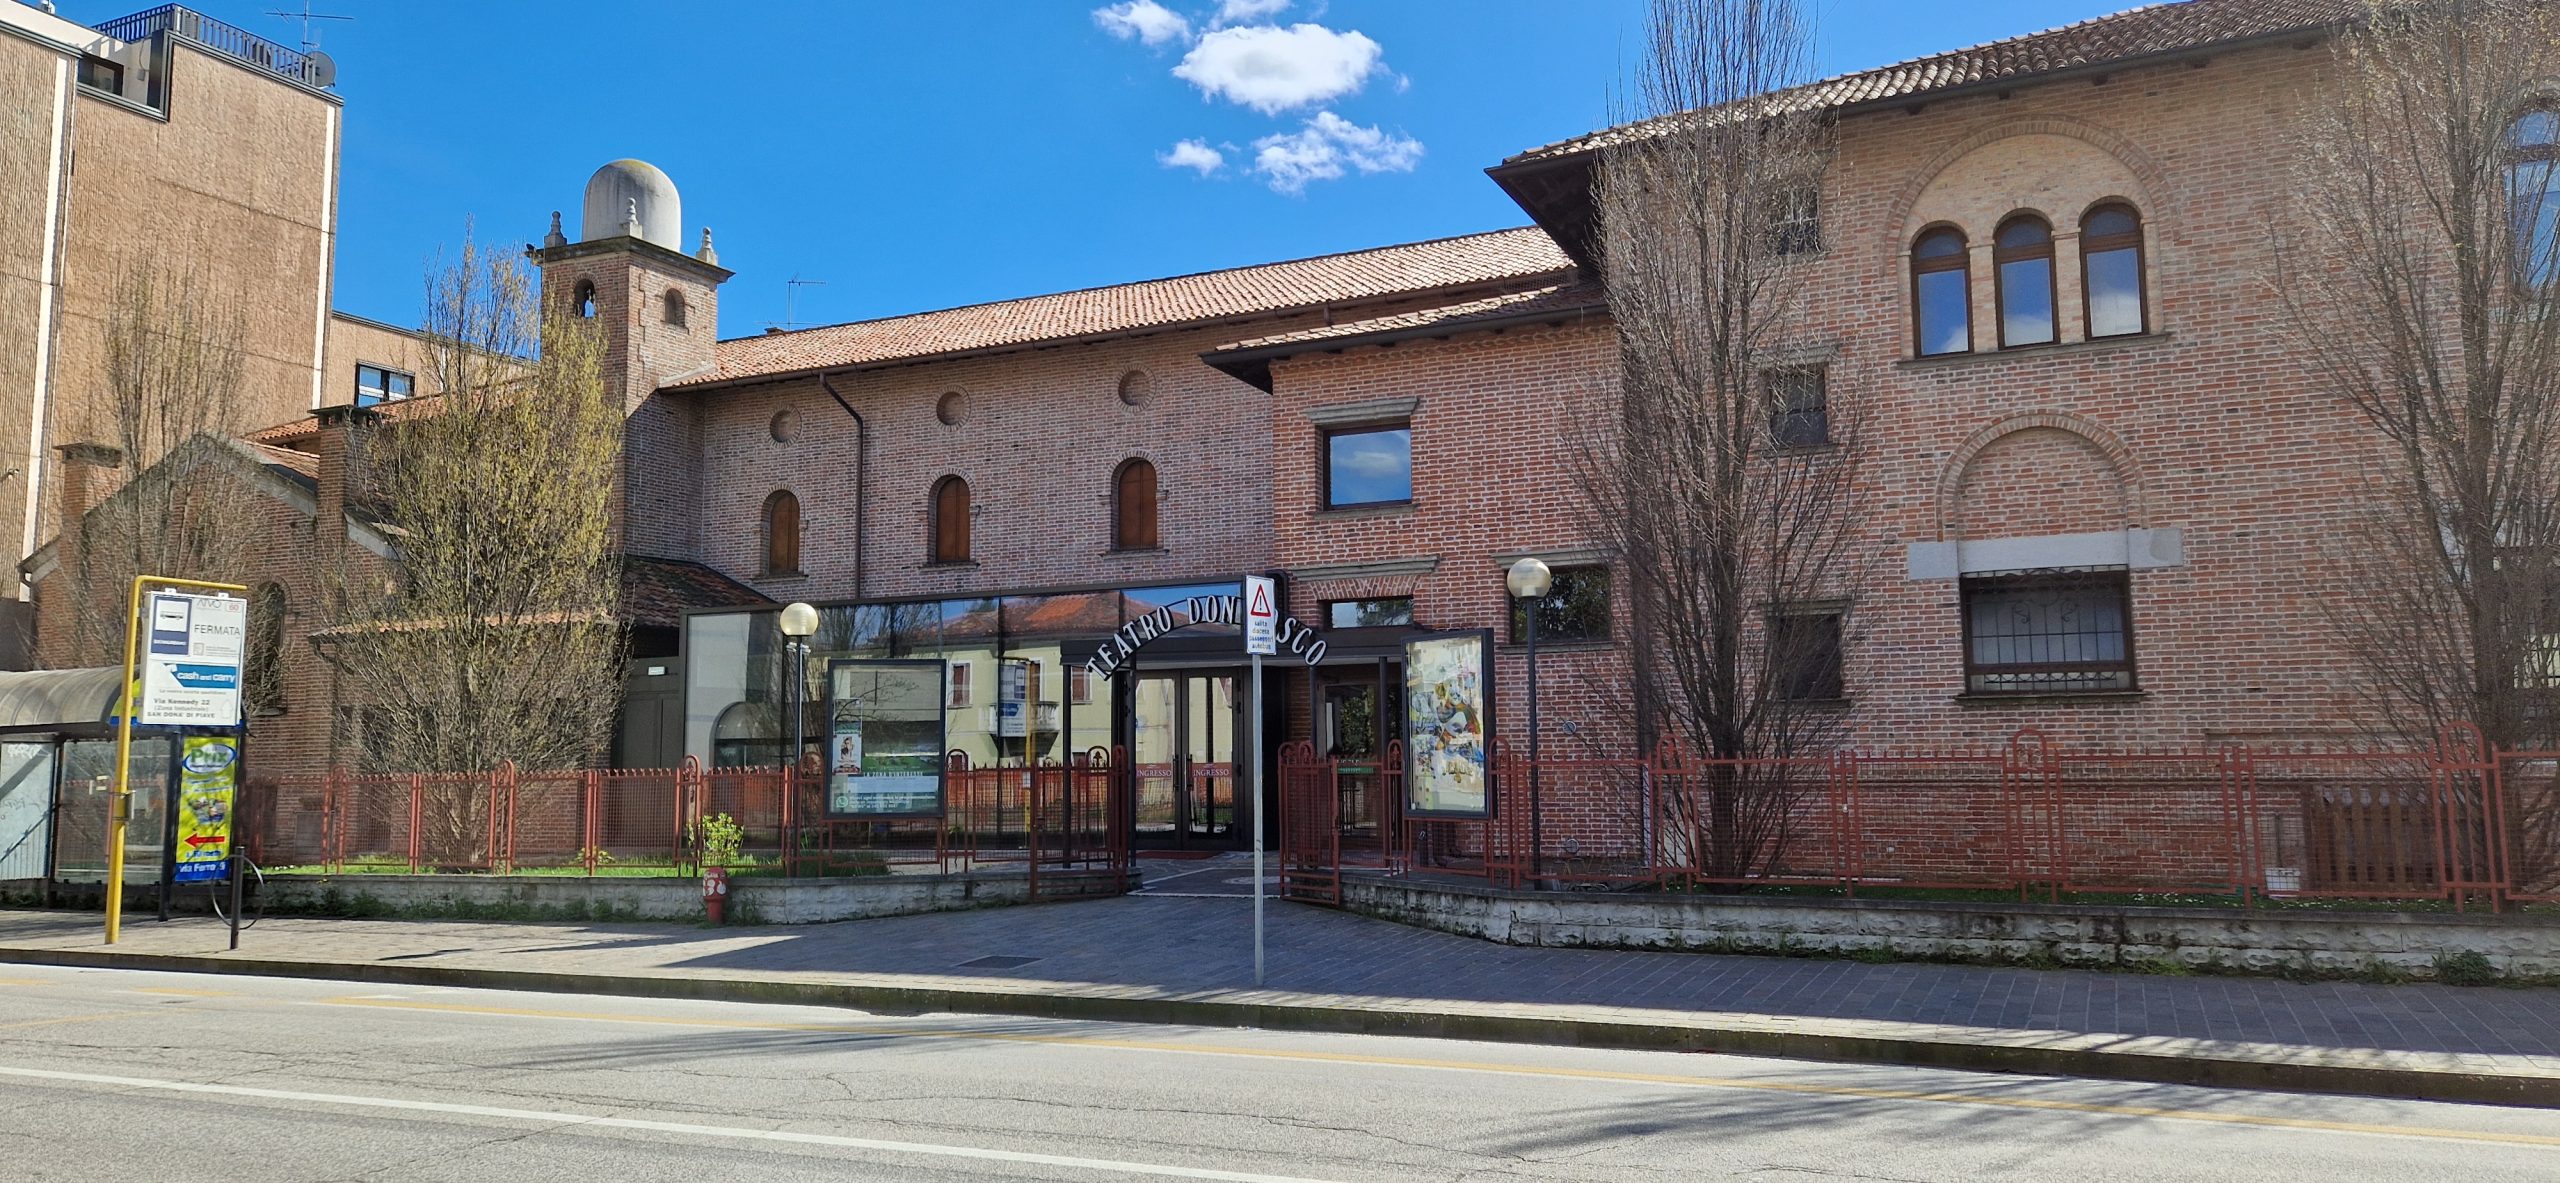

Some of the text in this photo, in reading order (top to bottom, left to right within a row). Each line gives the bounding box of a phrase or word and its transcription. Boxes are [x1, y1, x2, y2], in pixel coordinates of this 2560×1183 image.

[194, 624, 241, 636] FERMATA
[1085, 595, 1328, 681] TEATRO DON SCO
[177, 671, 199, 681] cash
[212, 674, 236, 683] carry
[168, 698, 199, 706] Kennedy
[191, 748, 228, 763] Prix
[1136, 769, 1172, 777] INGRESSO
[1193, 768, 1230, 777] INGRESSO
